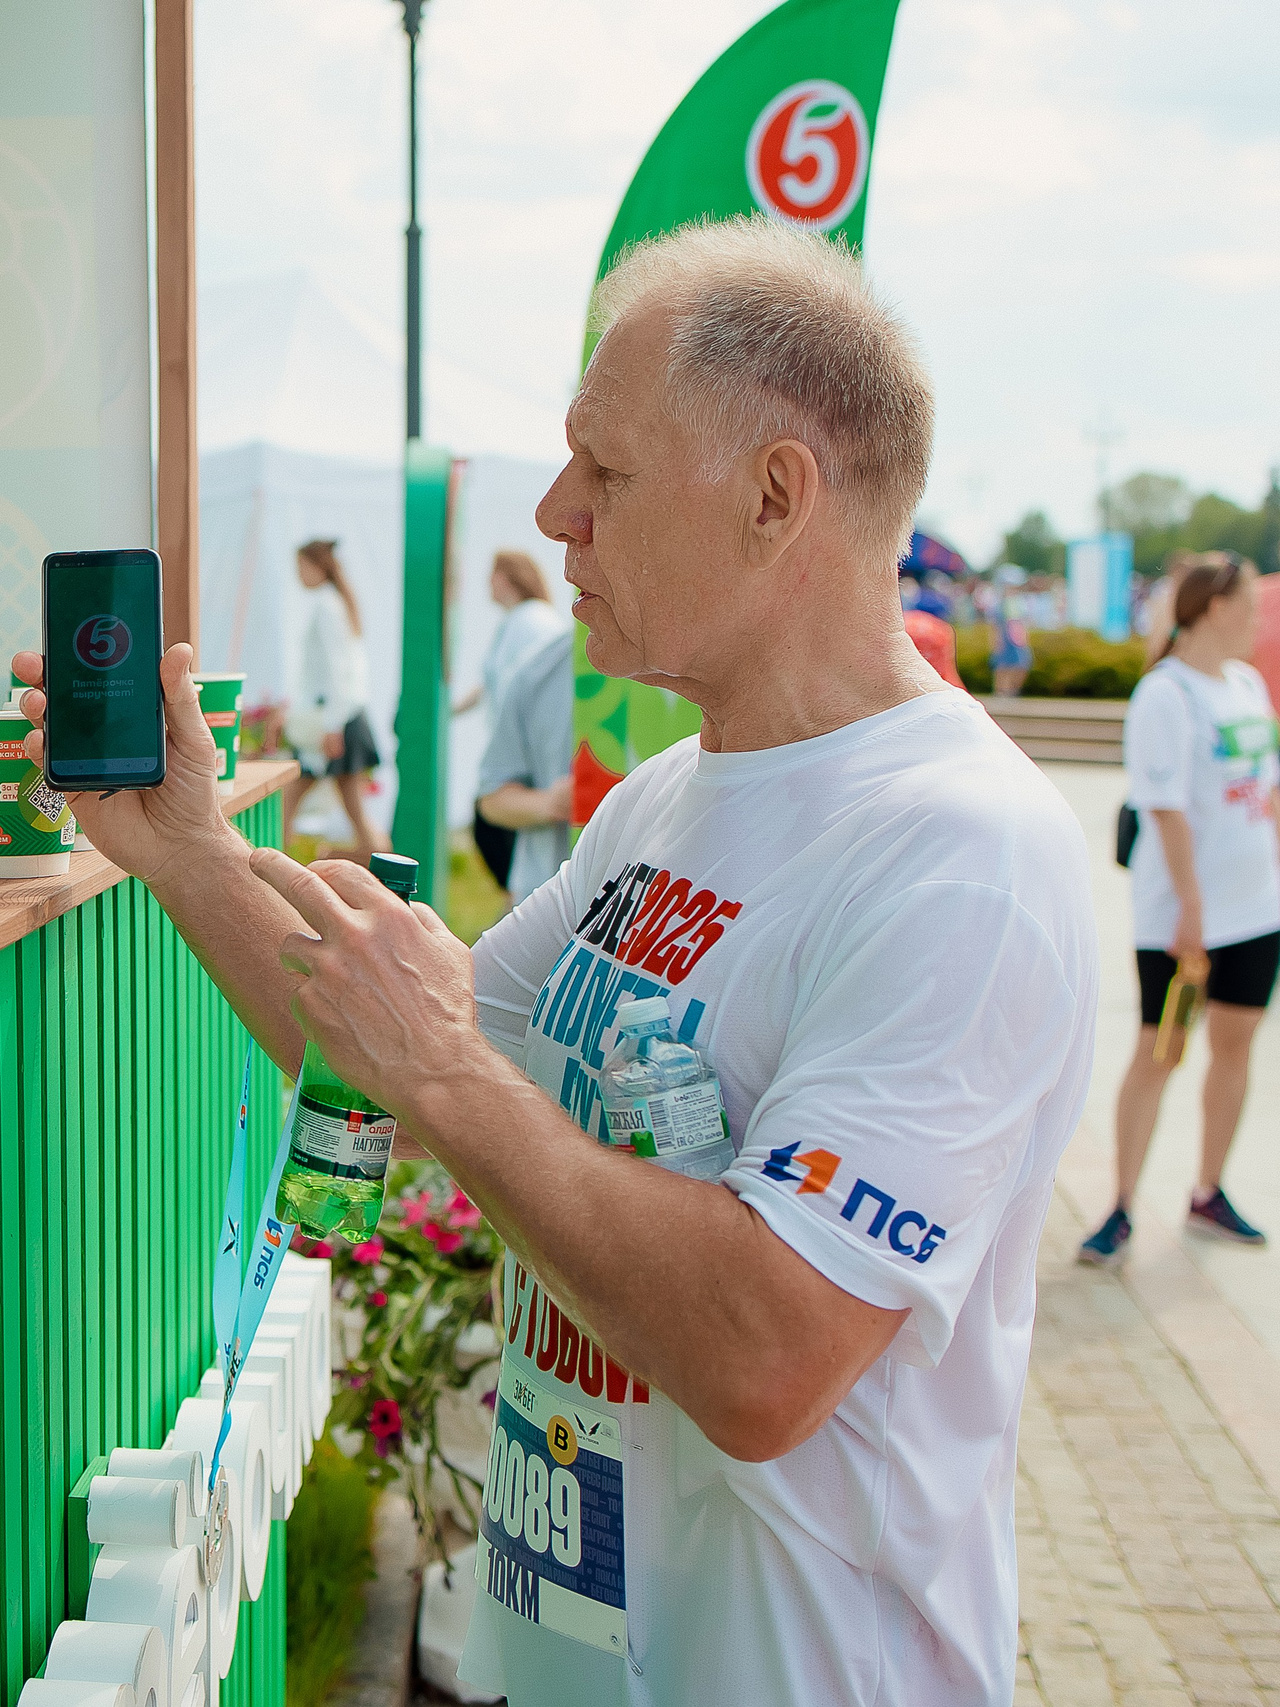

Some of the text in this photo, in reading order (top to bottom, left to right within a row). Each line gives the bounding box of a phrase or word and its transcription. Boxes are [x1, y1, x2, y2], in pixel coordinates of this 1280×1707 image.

[72, 678, 134, 690] Пятёрочка
[72, 688, 134, 700] выручает!
[840, 1178, 947, 1264] ПСБ
[253, 1245, 275, 1290] ПСБ
[482, 1426, 581, 1568] 0089
